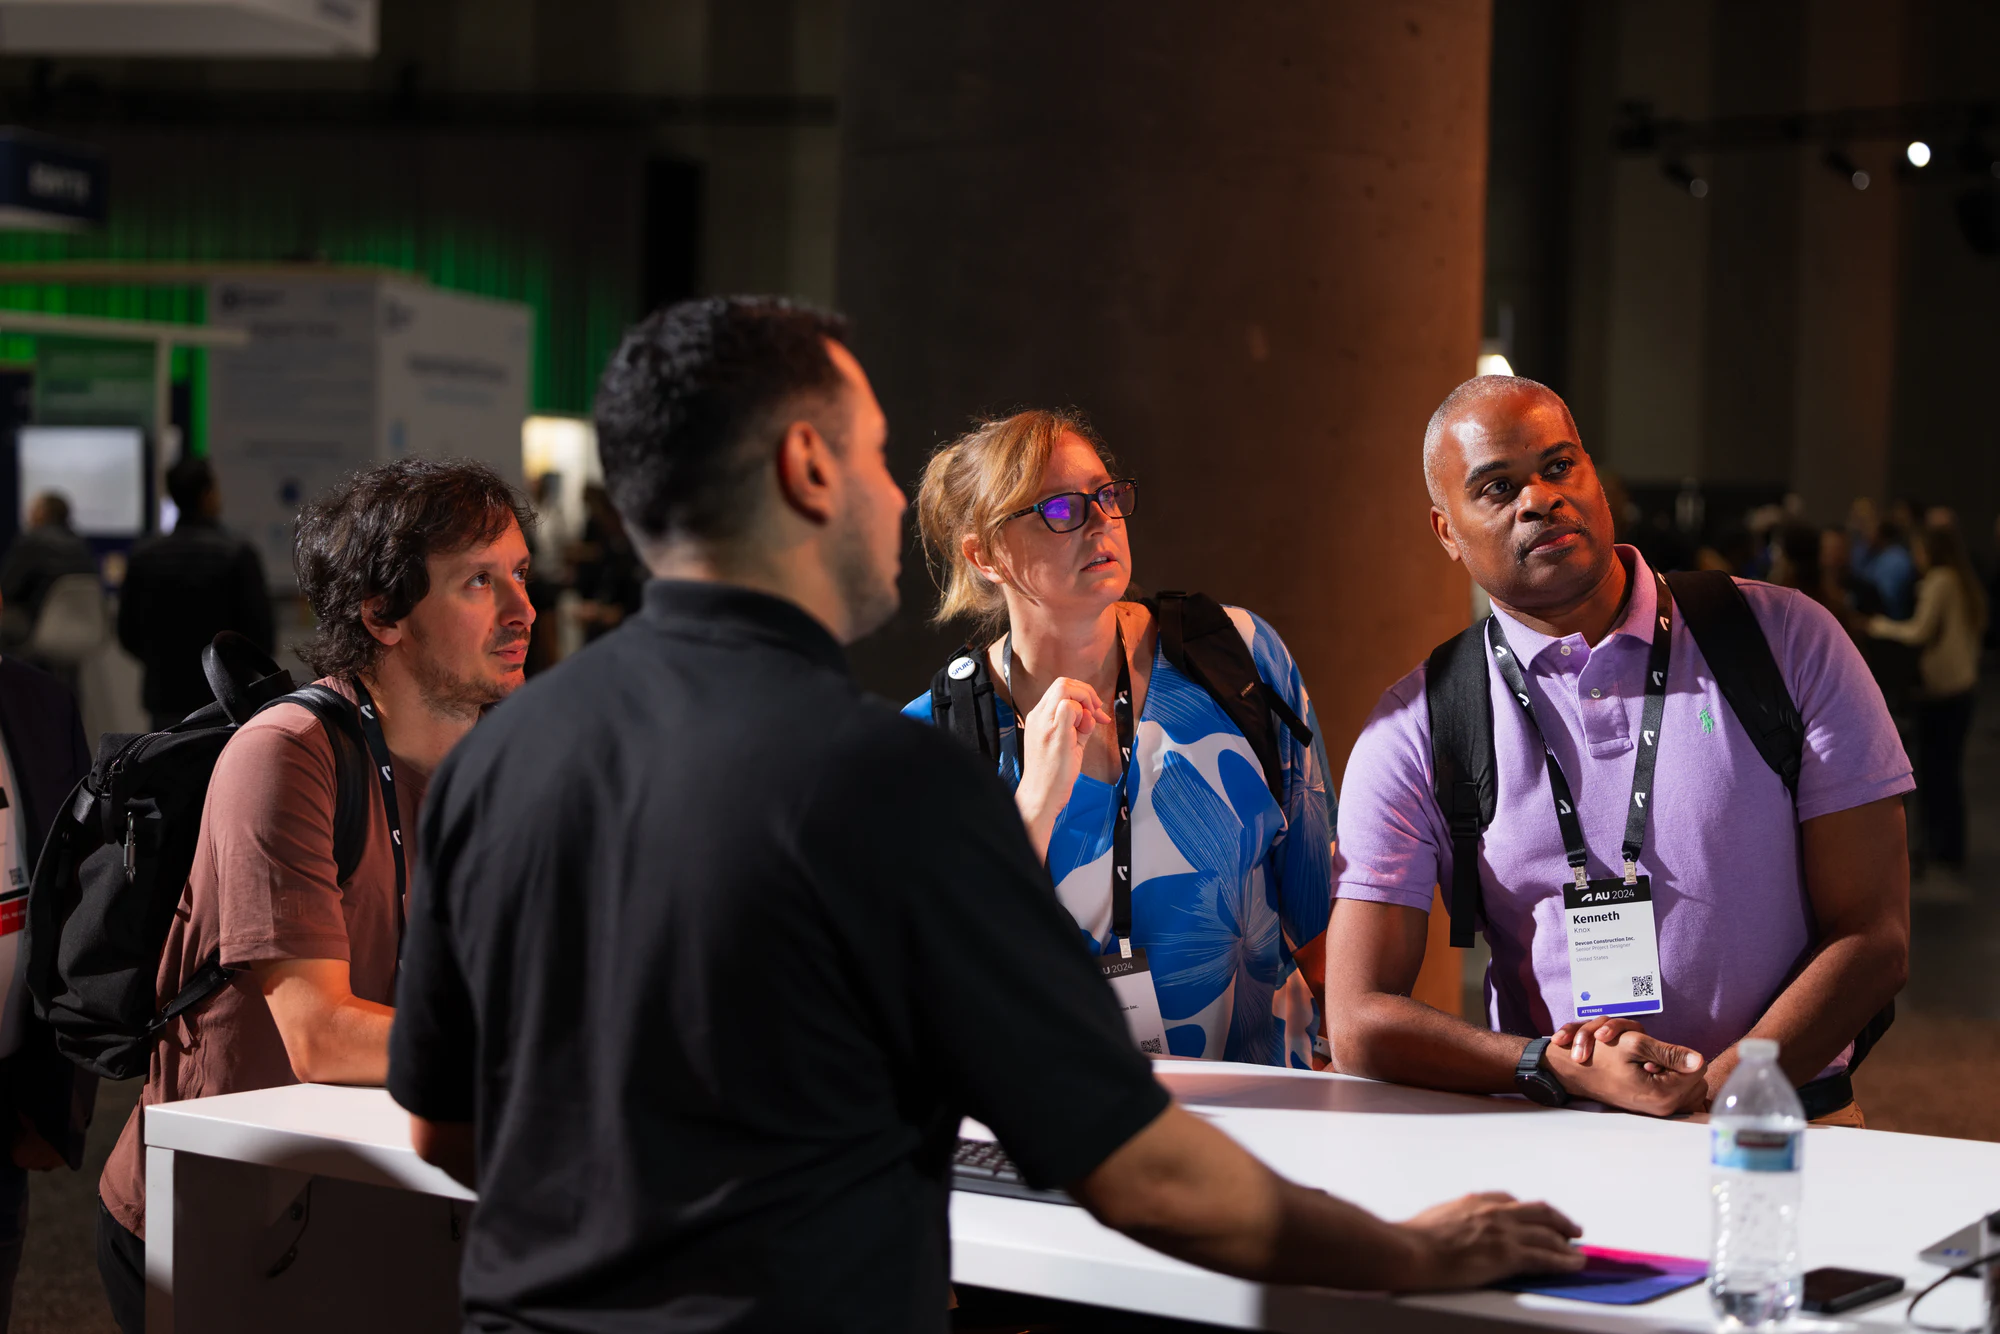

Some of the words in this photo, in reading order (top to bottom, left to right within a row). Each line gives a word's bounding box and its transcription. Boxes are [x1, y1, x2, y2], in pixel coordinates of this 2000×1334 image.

[951, 659, 974, 676] SPURS
[1594, 891, 1610, 901] AU
[1611, 889, 1635, 900] 2024
[1573, 911, 1620, 924] Kenneth
[1111, 962, 1133, 973] 2024
